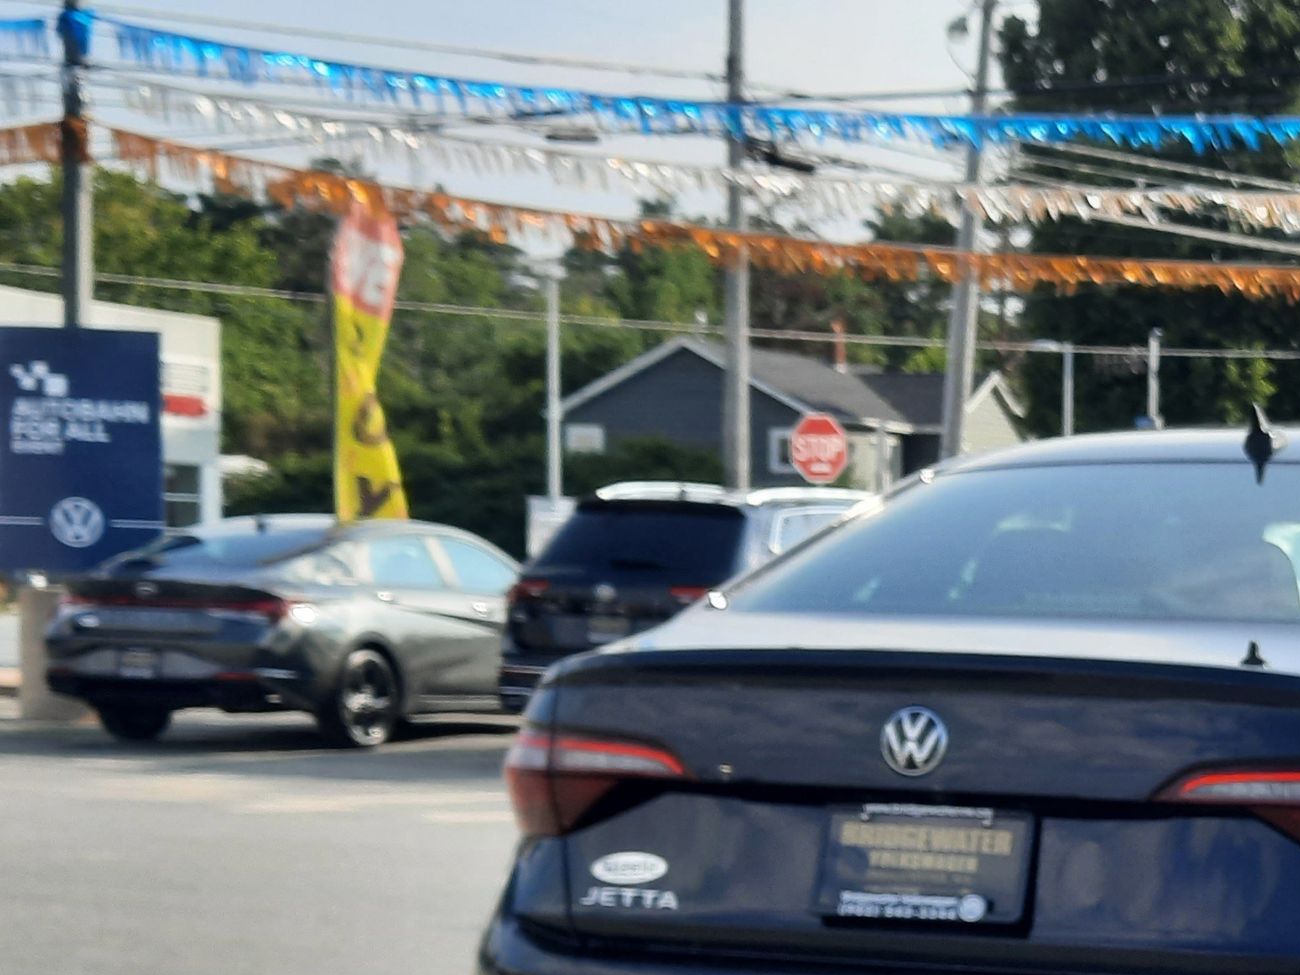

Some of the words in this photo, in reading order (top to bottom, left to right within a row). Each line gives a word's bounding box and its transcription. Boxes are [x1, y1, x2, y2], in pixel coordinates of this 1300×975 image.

[13, 398, 149, 424] AUTOBAHN
[12, 420, 60, 440] FOR
[65, 422, 109, 442] ALL
[793, 434, 844, 462] STOP
[580, 886, 678, 911] JETTA
